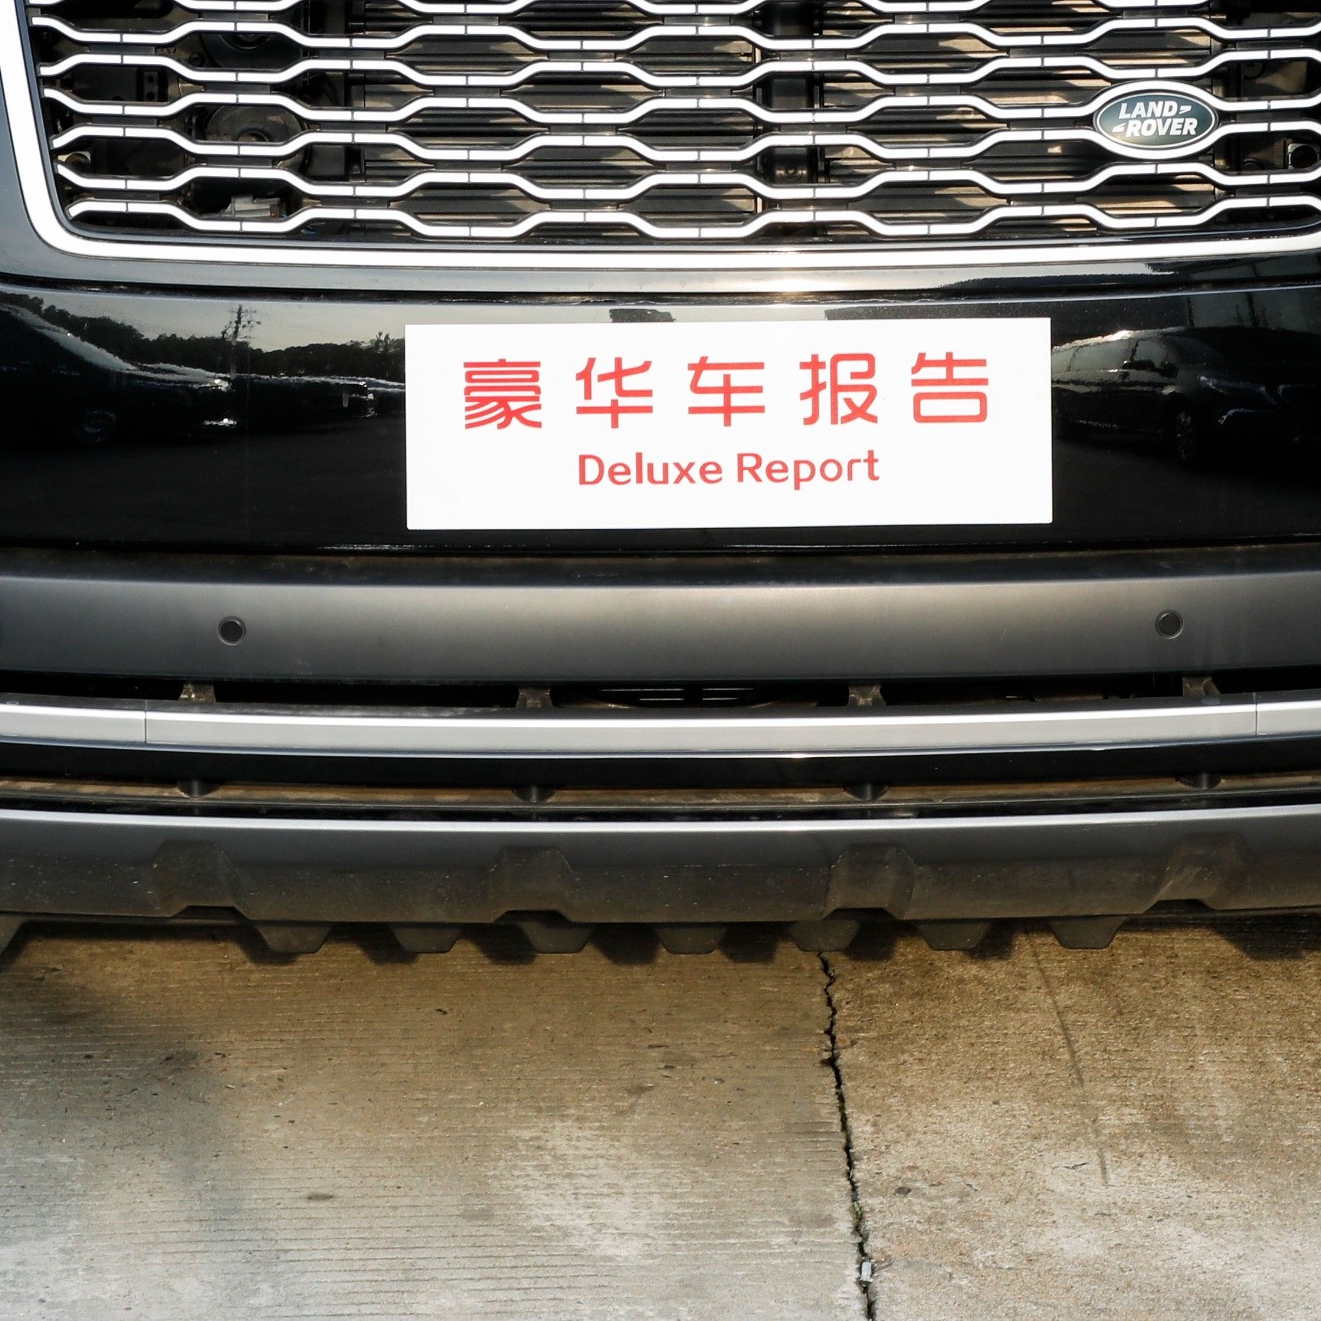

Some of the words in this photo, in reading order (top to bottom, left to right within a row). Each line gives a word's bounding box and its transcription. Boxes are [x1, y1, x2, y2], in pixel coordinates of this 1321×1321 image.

[1118, 100, 1179, 119] LAND
[1125, 117, 1199, 138] ROVER
[463, 351, 989, 430] 豪华车报告
[578, 452, 723, 486] Deluxe
[736, 449, 880, 491] Report
